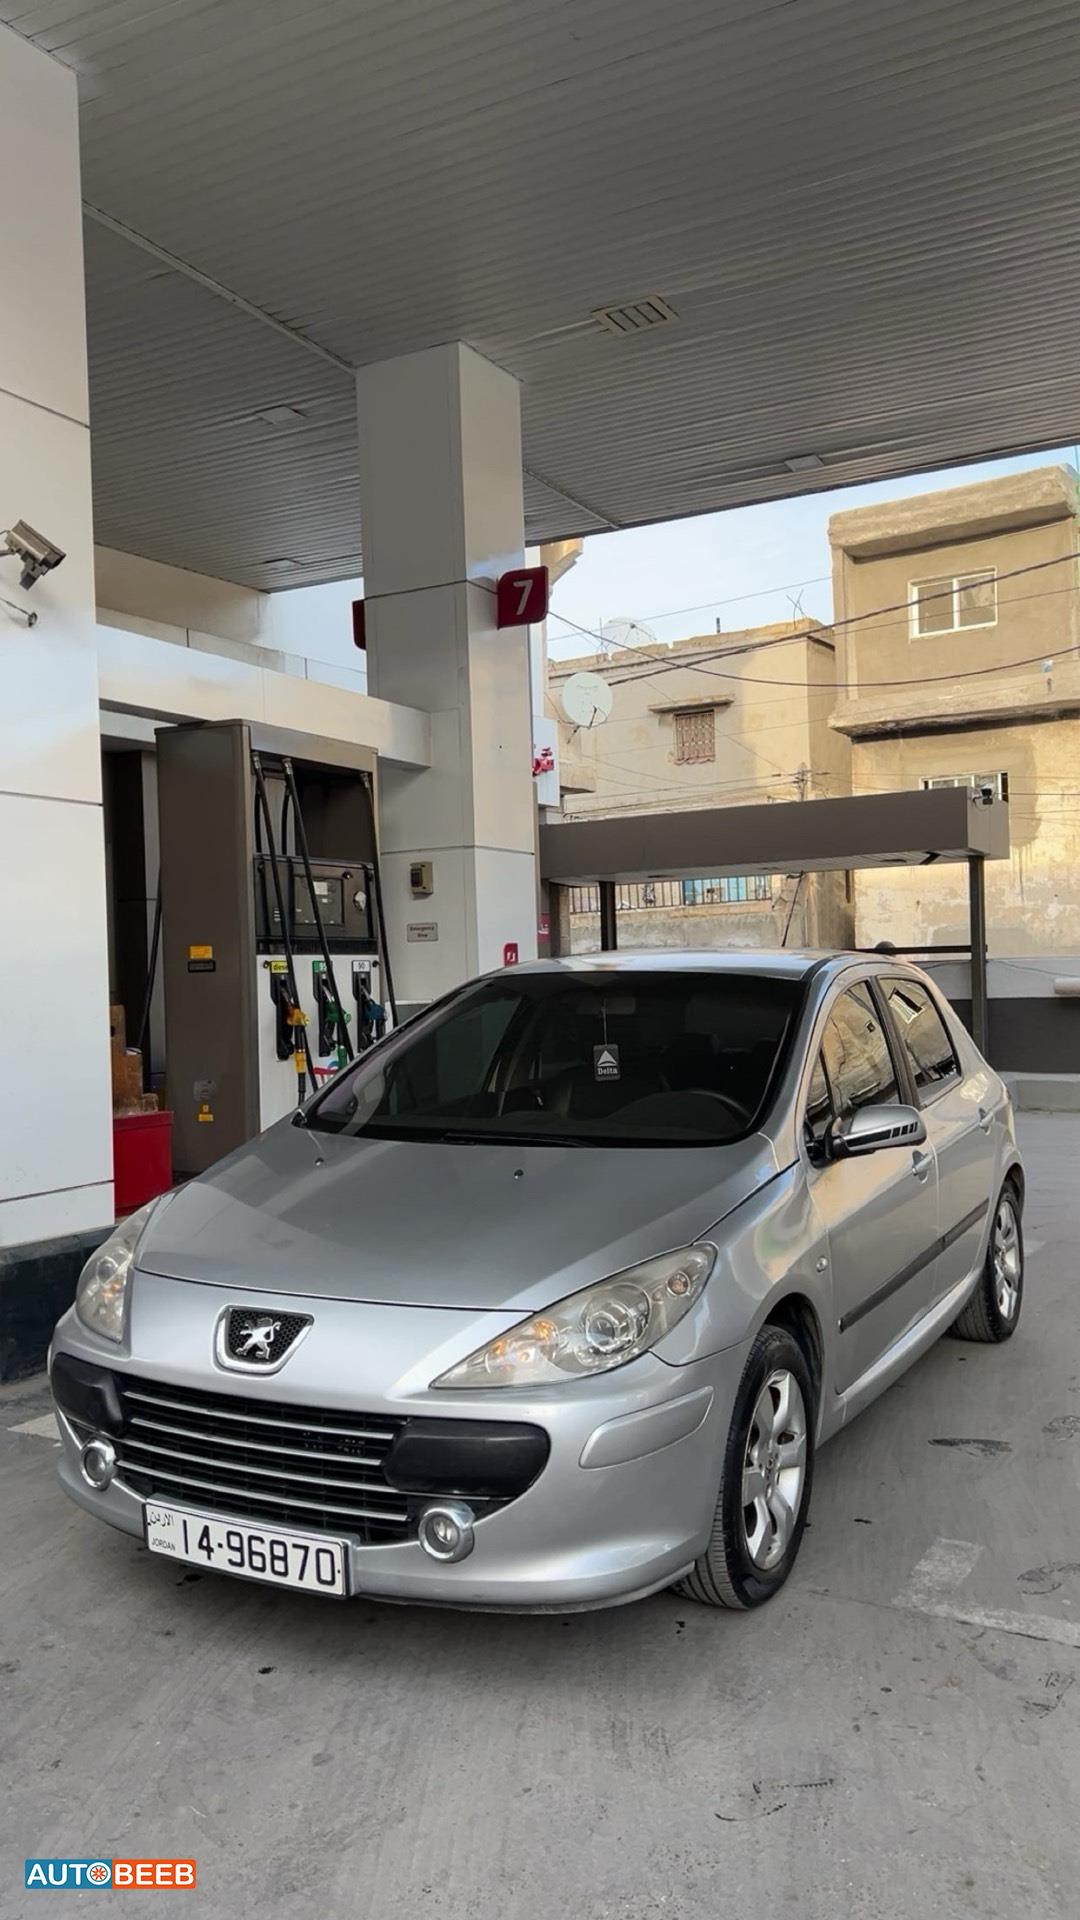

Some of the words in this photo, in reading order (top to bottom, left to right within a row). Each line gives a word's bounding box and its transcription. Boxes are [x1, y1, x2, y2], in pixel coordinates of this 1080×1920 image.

[513, 579, 533, 615] 7
[597, 1067, 618, 1075] Delta
[152, 1537, 176, 1551] JORDAN
[183, 1519, 336, 1586] 14-96870
